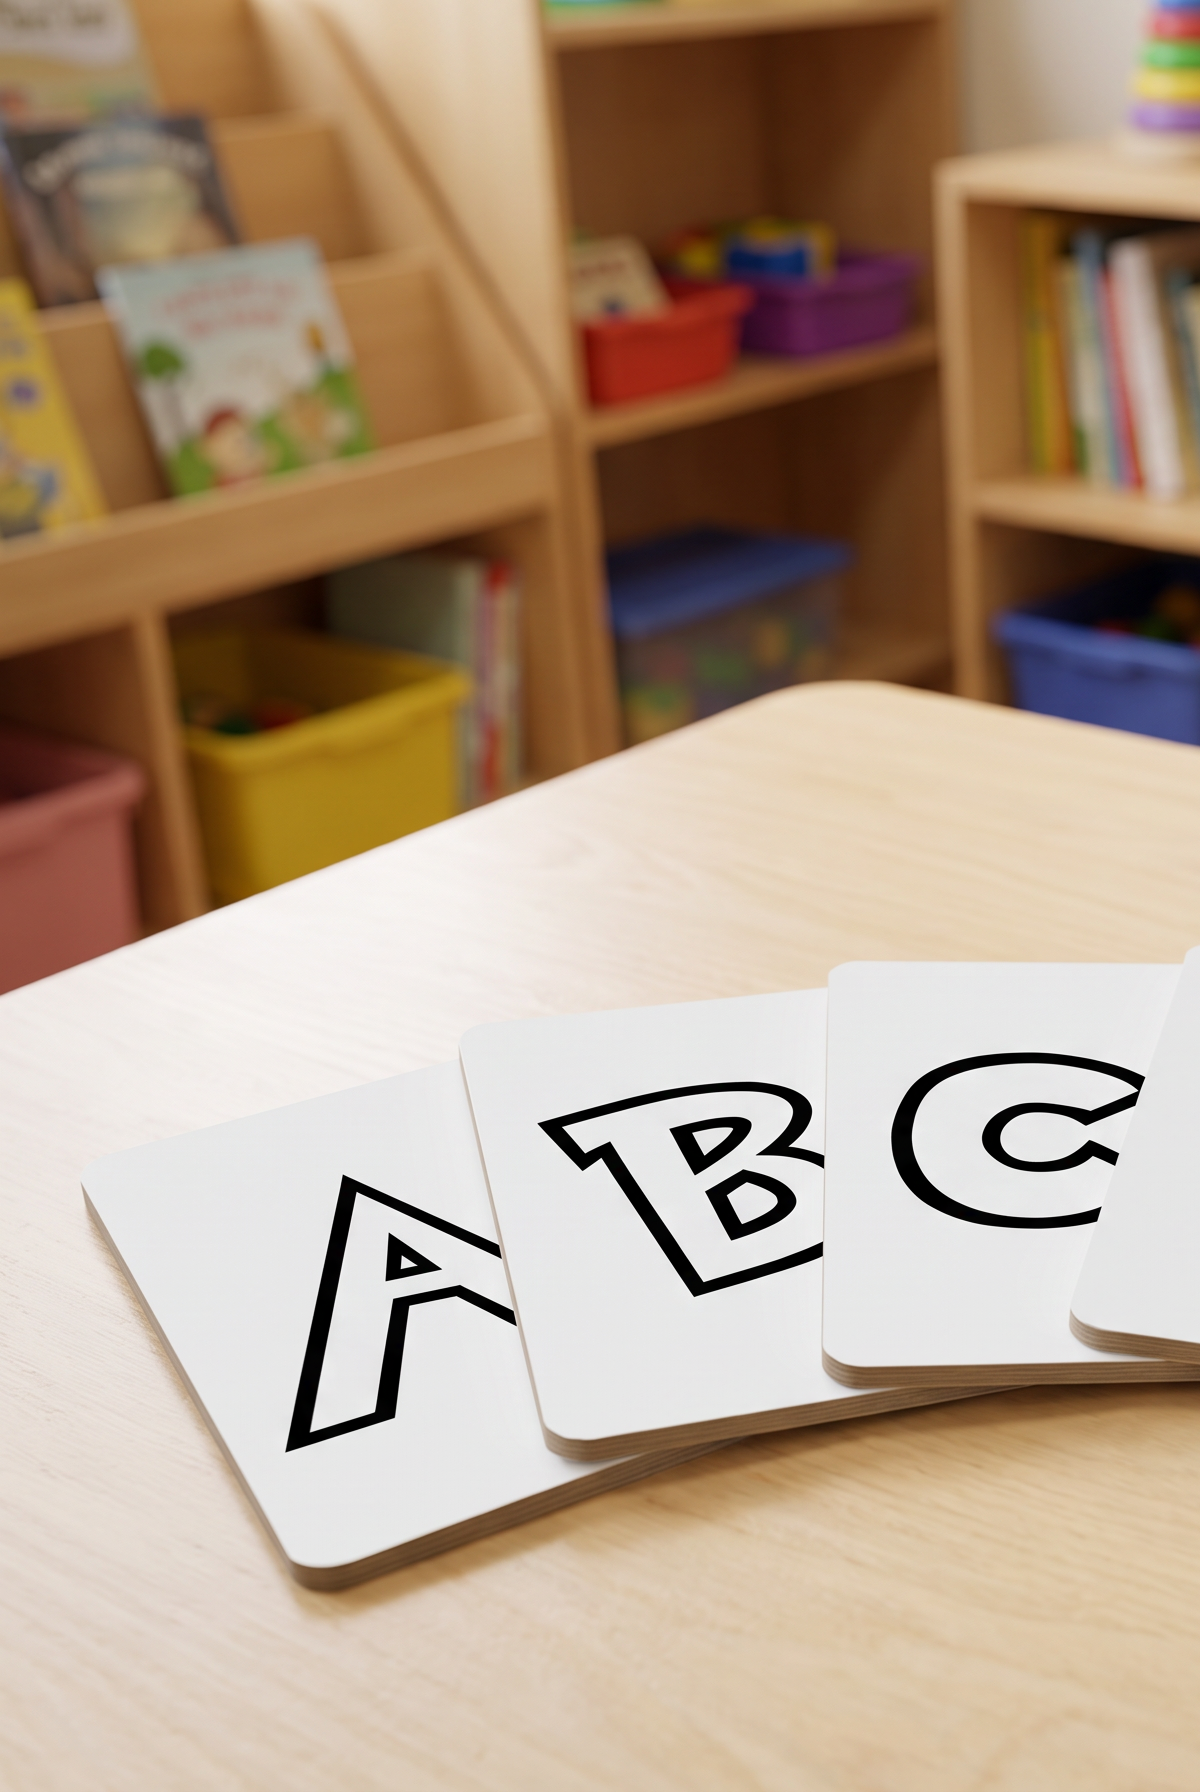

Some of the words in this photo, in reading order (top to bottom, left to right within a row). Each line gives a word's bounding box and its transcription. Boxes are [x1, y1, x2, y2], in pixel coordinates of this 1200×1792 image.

[538, 1081, 824, 1298] B
[891, 1052, 1146, 1230] C
[286, 1175, 518, 1452] A
